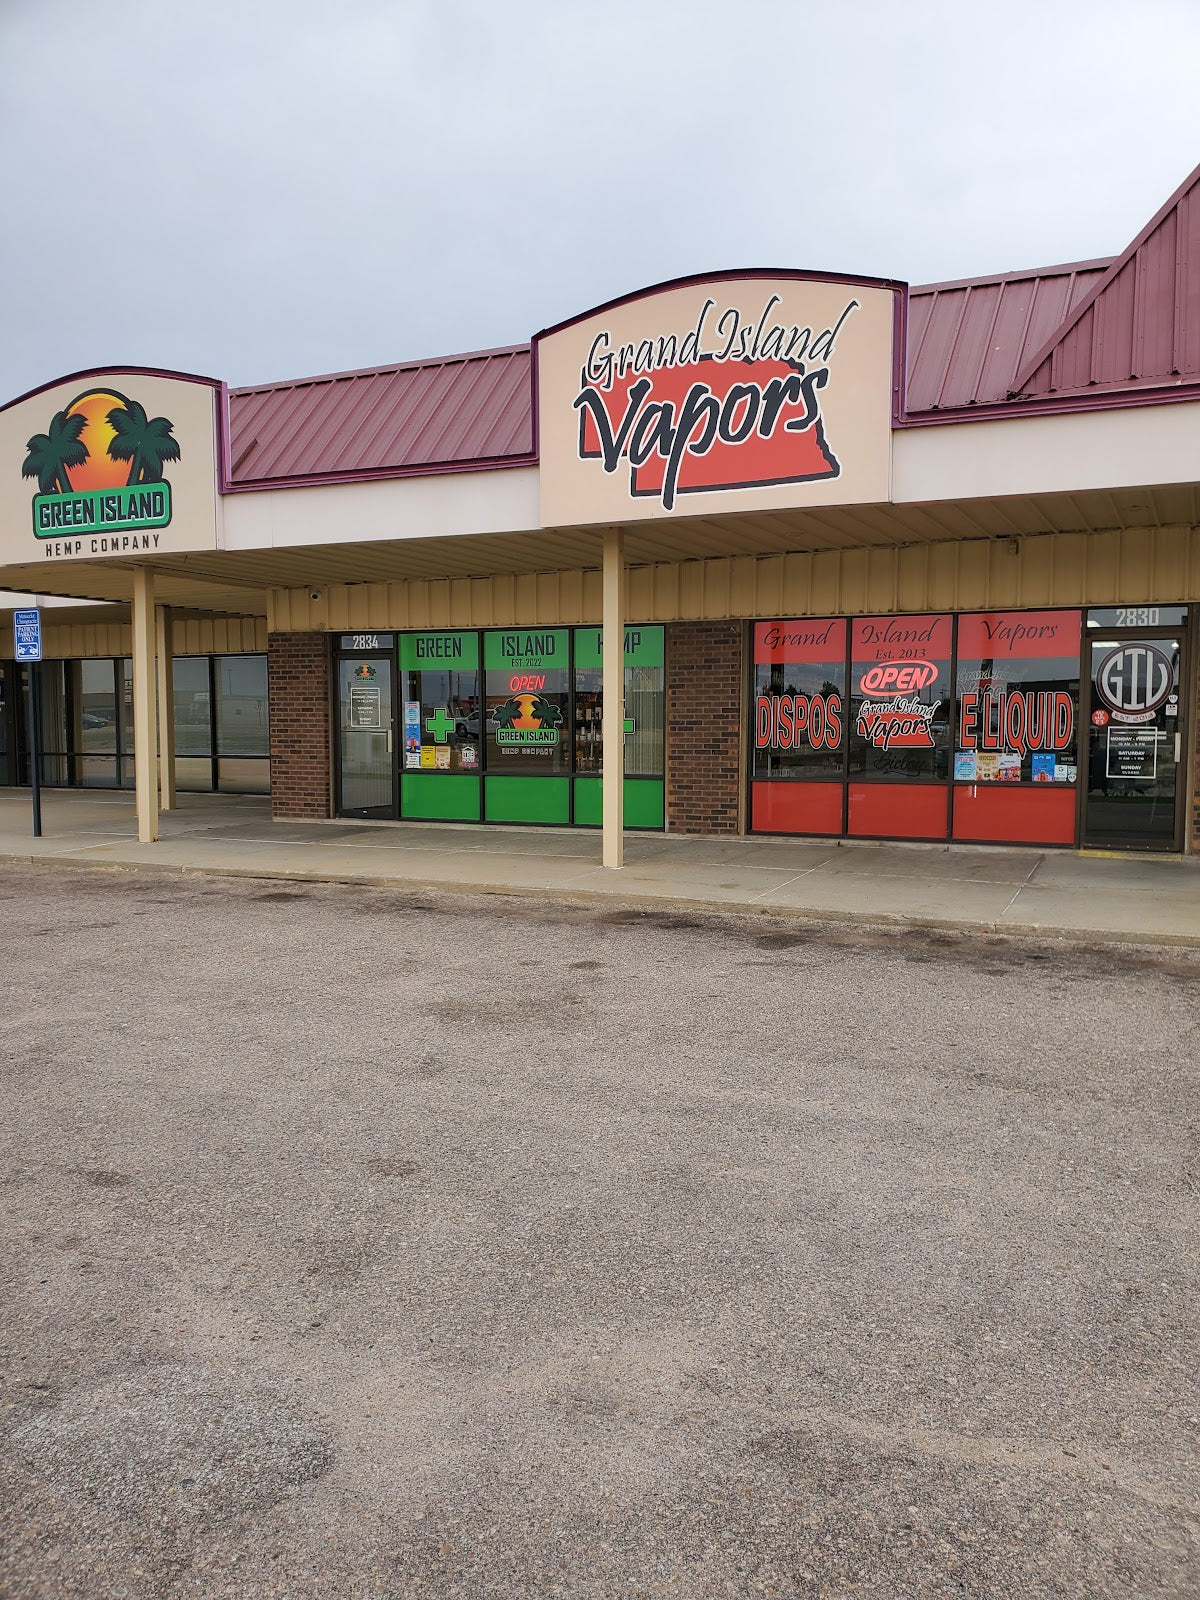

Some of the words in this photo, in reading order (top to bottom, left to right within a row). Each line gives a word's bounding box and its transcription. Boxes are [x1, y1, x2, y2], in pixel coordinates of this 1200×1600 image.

[586, 298, 715, 389] Grand
[717, 295, 860, 363] Island
[573, 366, 829, 511] Vapors
[39, 497, 95, 530] GREEN
[99, 491, 165, 523] ISLAND
[45, 540, 82, 557] HEMP
[90, 534, 160, 553] COMPANY
[1115, 608, 1160, 627] 2830
[352, 634, 379, 650] 2834
[416, 637, 462, 658] GREEN
[501, 634, 556, 657] ISLAND
[597, 631, 642, 655] HMP
[763, 622, 836, 650] Grand
[860, 618, 942, 644] Island
[981, 620, 1059, 651] Vapors
[526, 658, 542, 667] 2022
[875, 649, 895, 660] Est.
[898, 648, 926, 659] 2013
[509, 674, 546, 692] OPEN
[864, 667, 930, 690] OPEN
[860, 696, 902, 718] Grand
[899, 696, 941, 718] Island
[755, 693, 842, 750] DISPOS
[856, 715, 933, 751] Vapors
[960, 692, 978, 749] E
[982, 691, 1074, 761] LIQUID
[499, 731, 525, 742] GREEN
[526, 731, 555, 742] ISLAND
